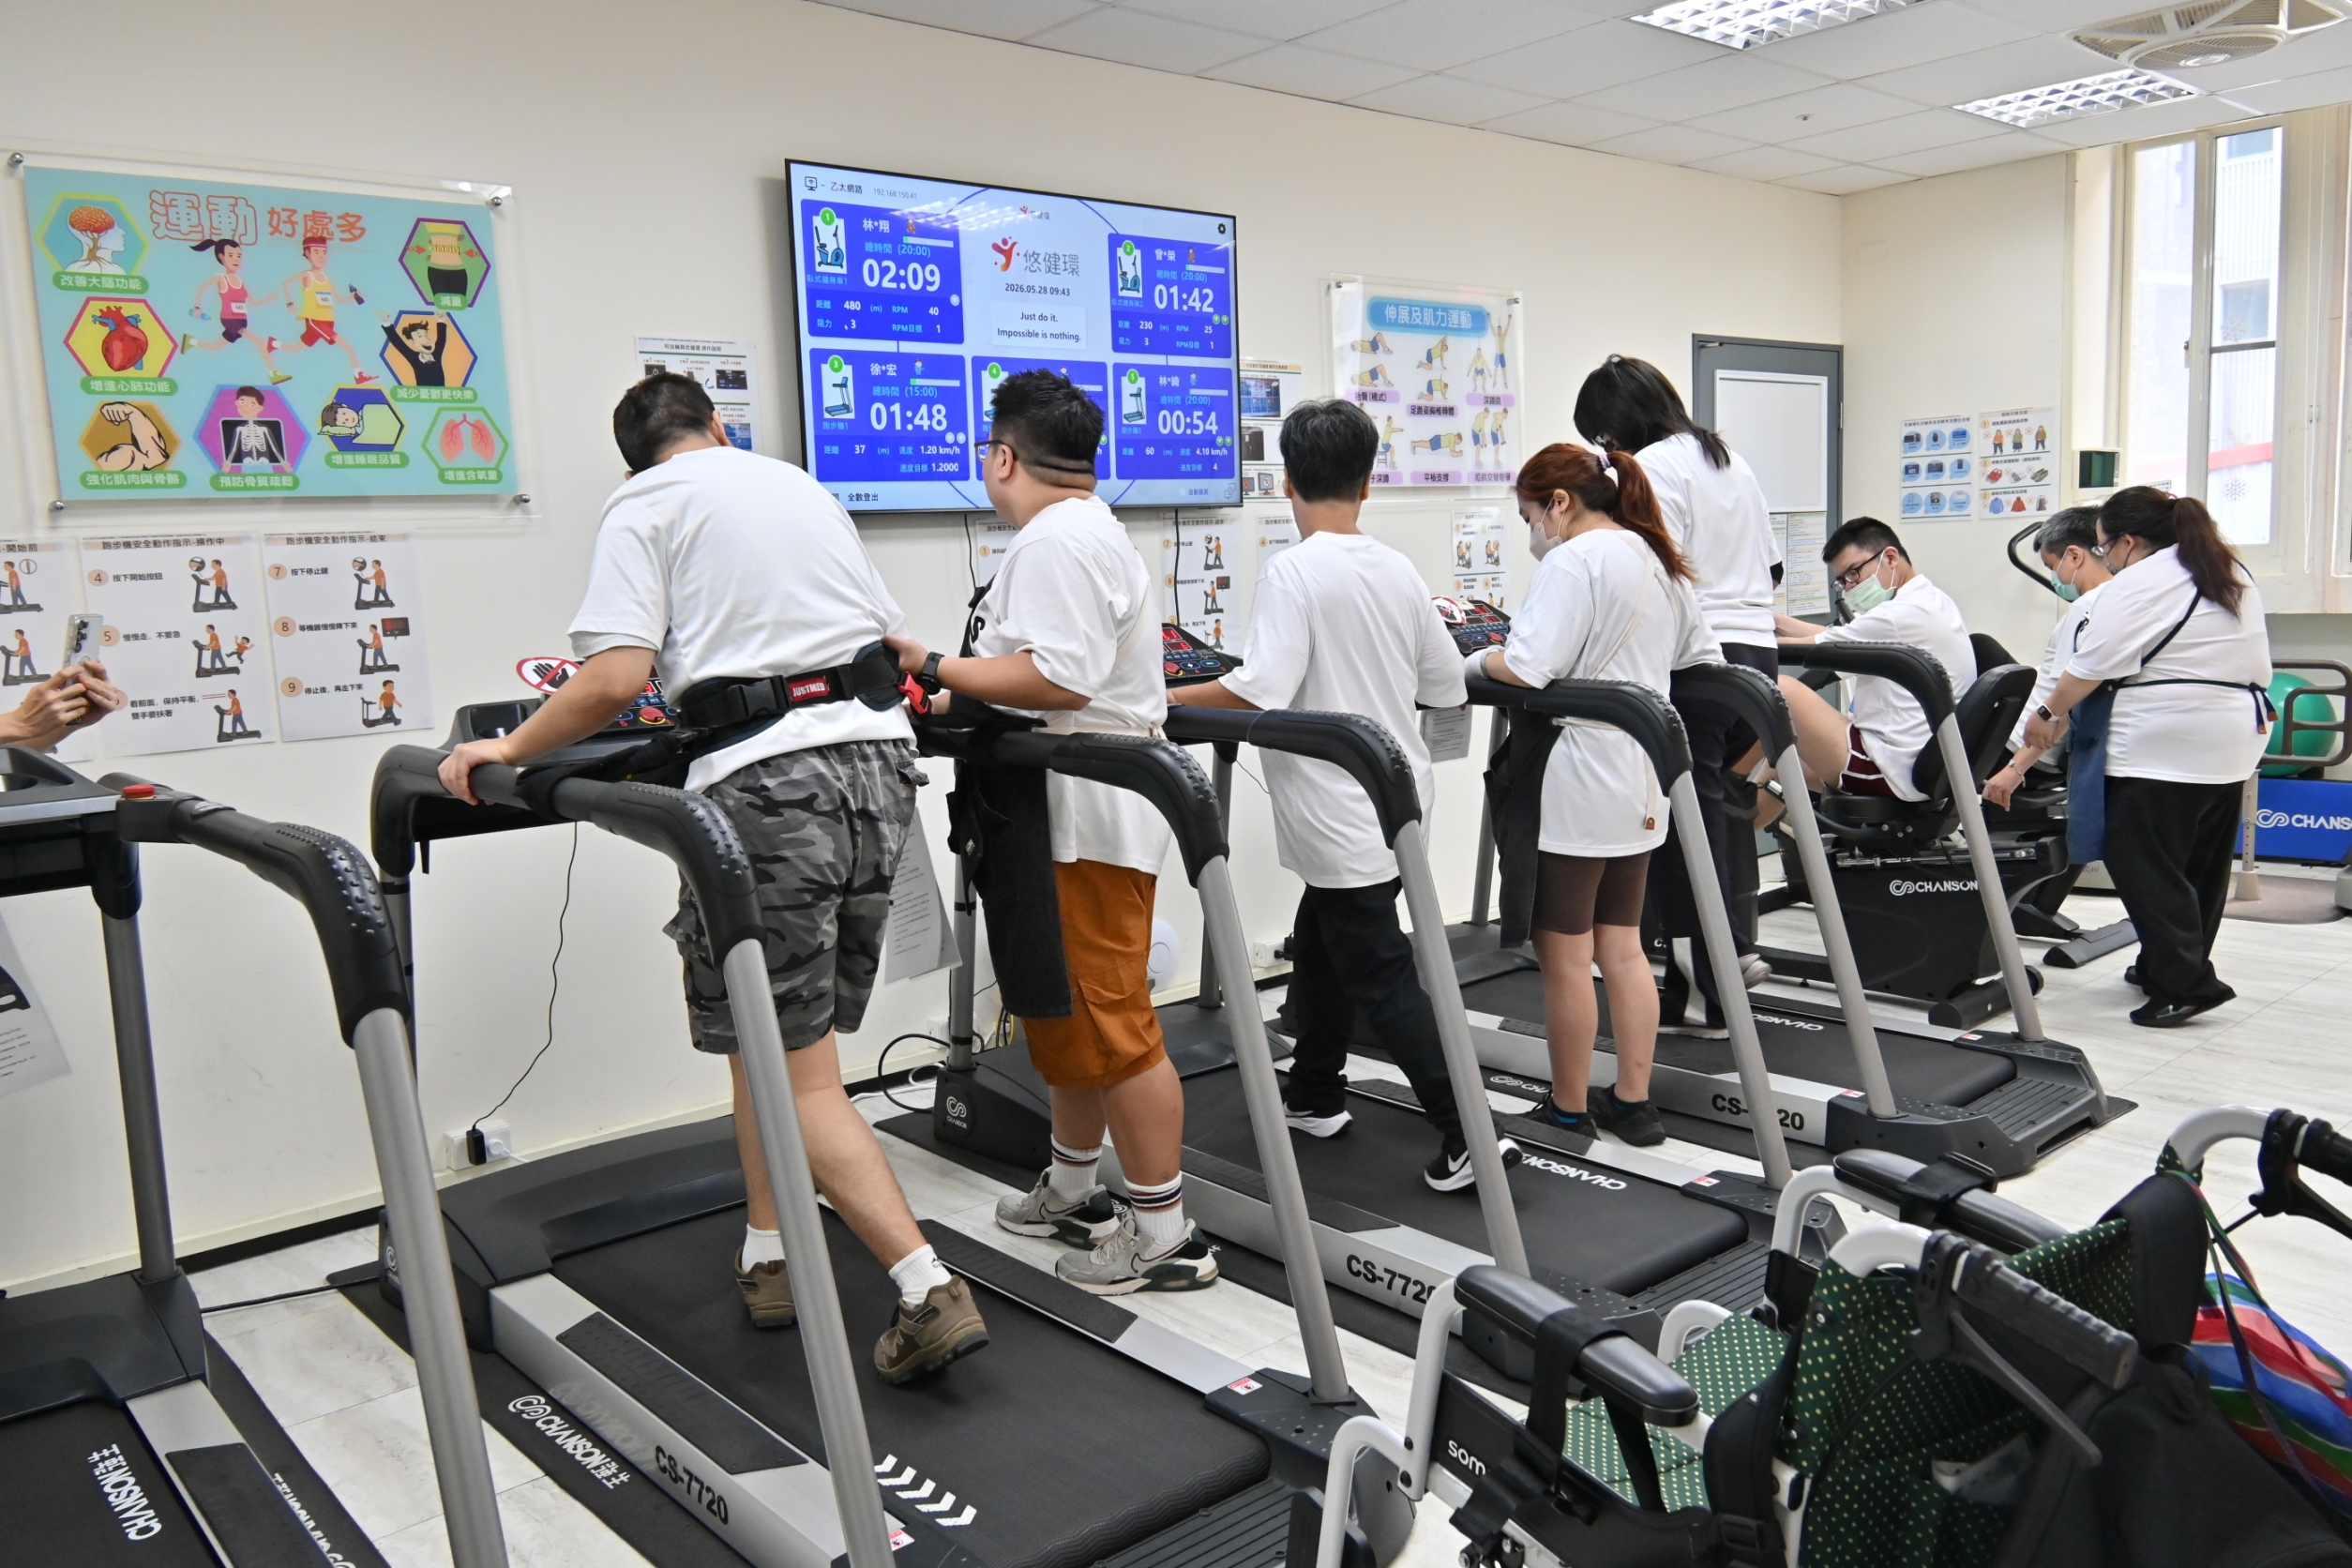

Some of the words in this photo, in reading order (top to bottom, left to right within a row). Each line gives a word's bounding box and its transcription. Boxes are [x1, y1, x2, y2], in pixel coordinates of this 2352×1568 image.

[830, 181, 863, 194] 乙太網路
[873, 188, 917, 200] 192.168.150.41
[149, 189, 258, 246] 運動
[267, 206, 367, 243] 好處多
[865, 241, 892, 254] 總時間
[897, 244, 931, 258] (20:00)
[1023, 249, 1080, 277] 悠健環
[862, 258, 941, 292] 02:09
[1181, 271, 1208, 283] (20:00)
[59, 274, 142, 291] 改善大腦功能
[1004, 283, 1048, 295] 2026.05.28
[1049, 286, 1071, 296] 09:43
[439, 295, 462, 308] 減重
[1153, 283, 1214, 312] 01:42
[816, 299, 832, 309] 距離
[843, 300, 861, 310] 480
[870, 305, 882, 313] (m)
[892, 306, 909, 314] RPM
[928, 307, 939, 316] 40
[1020, 311, 1036, 322] Just
[1038, 312, 1048, 322] do
[1049, 313, 1059, 323] it.
[1384, 303, 1472, 329] 伸展及肌力運動
[817, 319, 832, 328] 阻力
[1139, 321, 1153, 330] 230
[1159, 324, 1169, 333] (m)
[1204, 325, 1213, 334] 25
[997, 327, 1040, 339] Impossible
[1041, 330, 1048, 339] is
[1049, 330, 1081, 343] nothing.
[90, 379, 171, 393] 增進心肺功能
[905, 386, 938, 398] (15:00)
[396, 387, 475, 400] 減少憂鬱更快樂
[1184, 396, 1211, 406] (20:00)
[870, 401, 948, 431] 01:48
[1158, 409, 1219, 435] 00:54
[823, 445, 839, 454] 距離
[854, 445, 866, 454] 37
[878, 446, 890, 456] (m)
[898, 445, 913, 455] 速度
[920, 445, 937, 455] 1.20
[939, 445, 960, 456] km/h
[1145, 446, 1154, 456] 60
[1196, 447, 1210, 456] 4.10
[1211, 447, 1229, 457] km/h
[331, 453, 402, 466] 增進睡眠品質
[931, 462, 959, 472] 1.2000
[85, 473, 180, 486] 強化肌肉與骨骼
[219, 475, 294, 489] 預防骨質疏鬆
[444, 470, 498, 481] 增進含氧量
[1424, 473, 1450, 483] 平板支撐
[847, 492, 879, 502] 全數登出
[101, 537, 225, 550] 跑步機安全動作指示-操作中
[285, 535, 386, 546] 跑步機安全動作指示-結束
[0, 543, 38, 553] -開始前
[94, 573, 102, 582] 4
[113, 572, 163, 582] 按下開始按鈕
[274, 566, 281, 577] 7
[291, 566, 329, 577] 按下停止鍵
[281, 622, 289, 632] 8
[103, 631, 112, 641] 5
[288, 683, 295, 692] 9
[792, 682, 825, 697] JUSTMED
[2291, 813, 2352, 831] CHANS
[1915, 880, 1979, 893] CHANSON
[1752, 1013, 1824, 1031] CHANSO
[1711, 1093, 1804, 1131] CS-20
[1523, 1155, 1627, 1190] CHANSON
[655, 1444, 729, 1526] CS-7720
